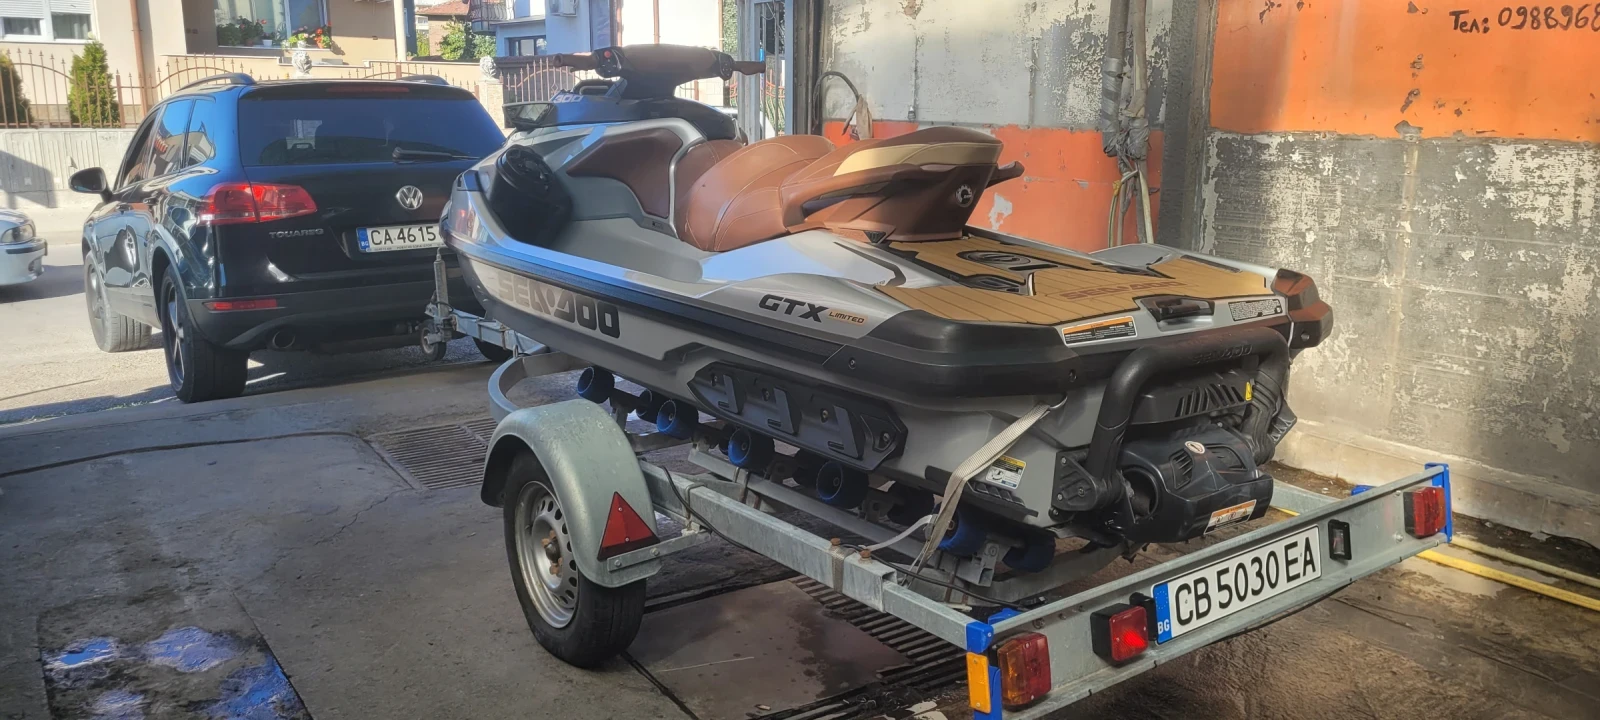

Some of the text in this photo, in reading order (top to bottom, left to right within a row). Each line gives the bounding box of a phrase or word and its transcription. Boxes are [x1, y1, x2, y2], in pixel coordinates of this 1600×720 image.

[1449, 9, 1490, 34] Тел:
[554, 94, 583, 103] 300
[269, 229, 324, 238] TOUAREG
[370, 225, 437, 246] CA 4615
[758, 293, 865, 324] GTX LIMITED
[1175, 537, 1316, 626] CB 5030 EA
[1157, 619, 1170, 635] BG
